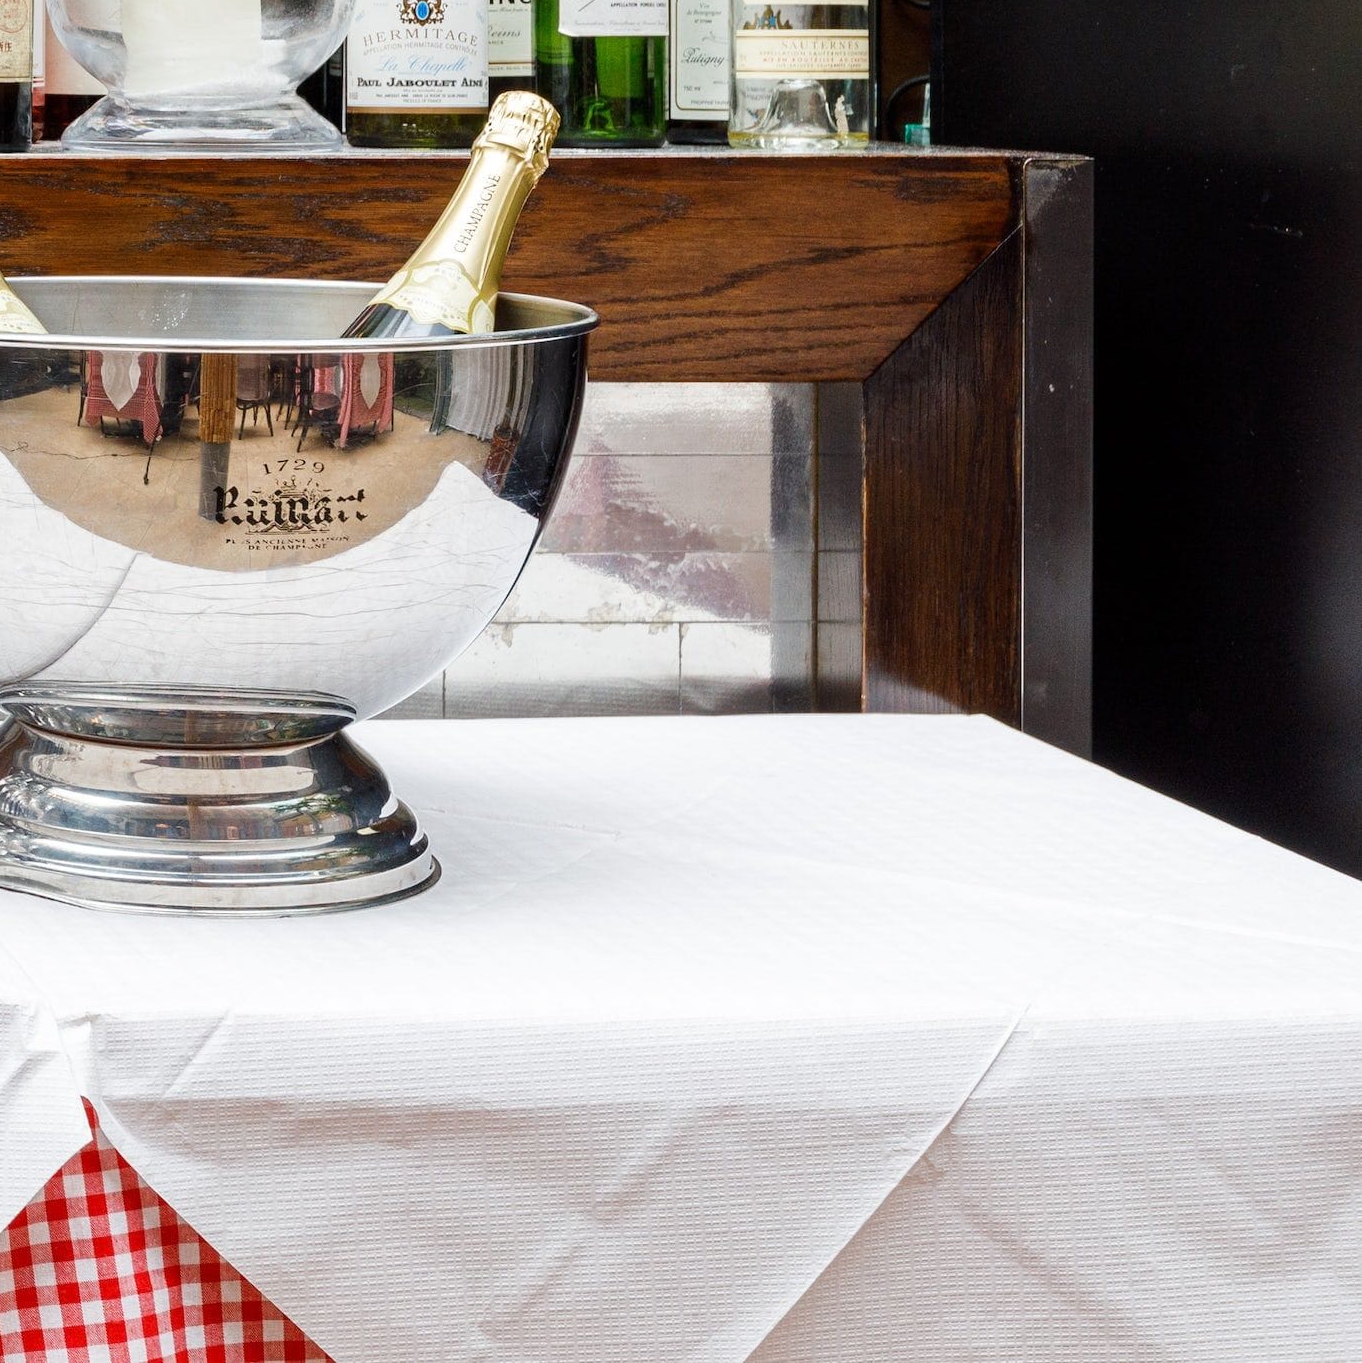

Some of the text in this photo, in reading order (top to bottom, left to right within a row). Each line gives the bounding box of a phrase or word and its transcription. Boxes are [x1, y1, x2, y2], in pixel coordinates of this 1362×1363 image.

[362, 27, 479, 48] HERMITAGE
[781, 40, 861, 50] SAUTERNES
[356, 77, 383, 88] PAUL
[386, 76, 457, 88] JABOULET
[452, 172, 502, 255] CHAMPAGNE
[262, 457, 326, 476] 1729
